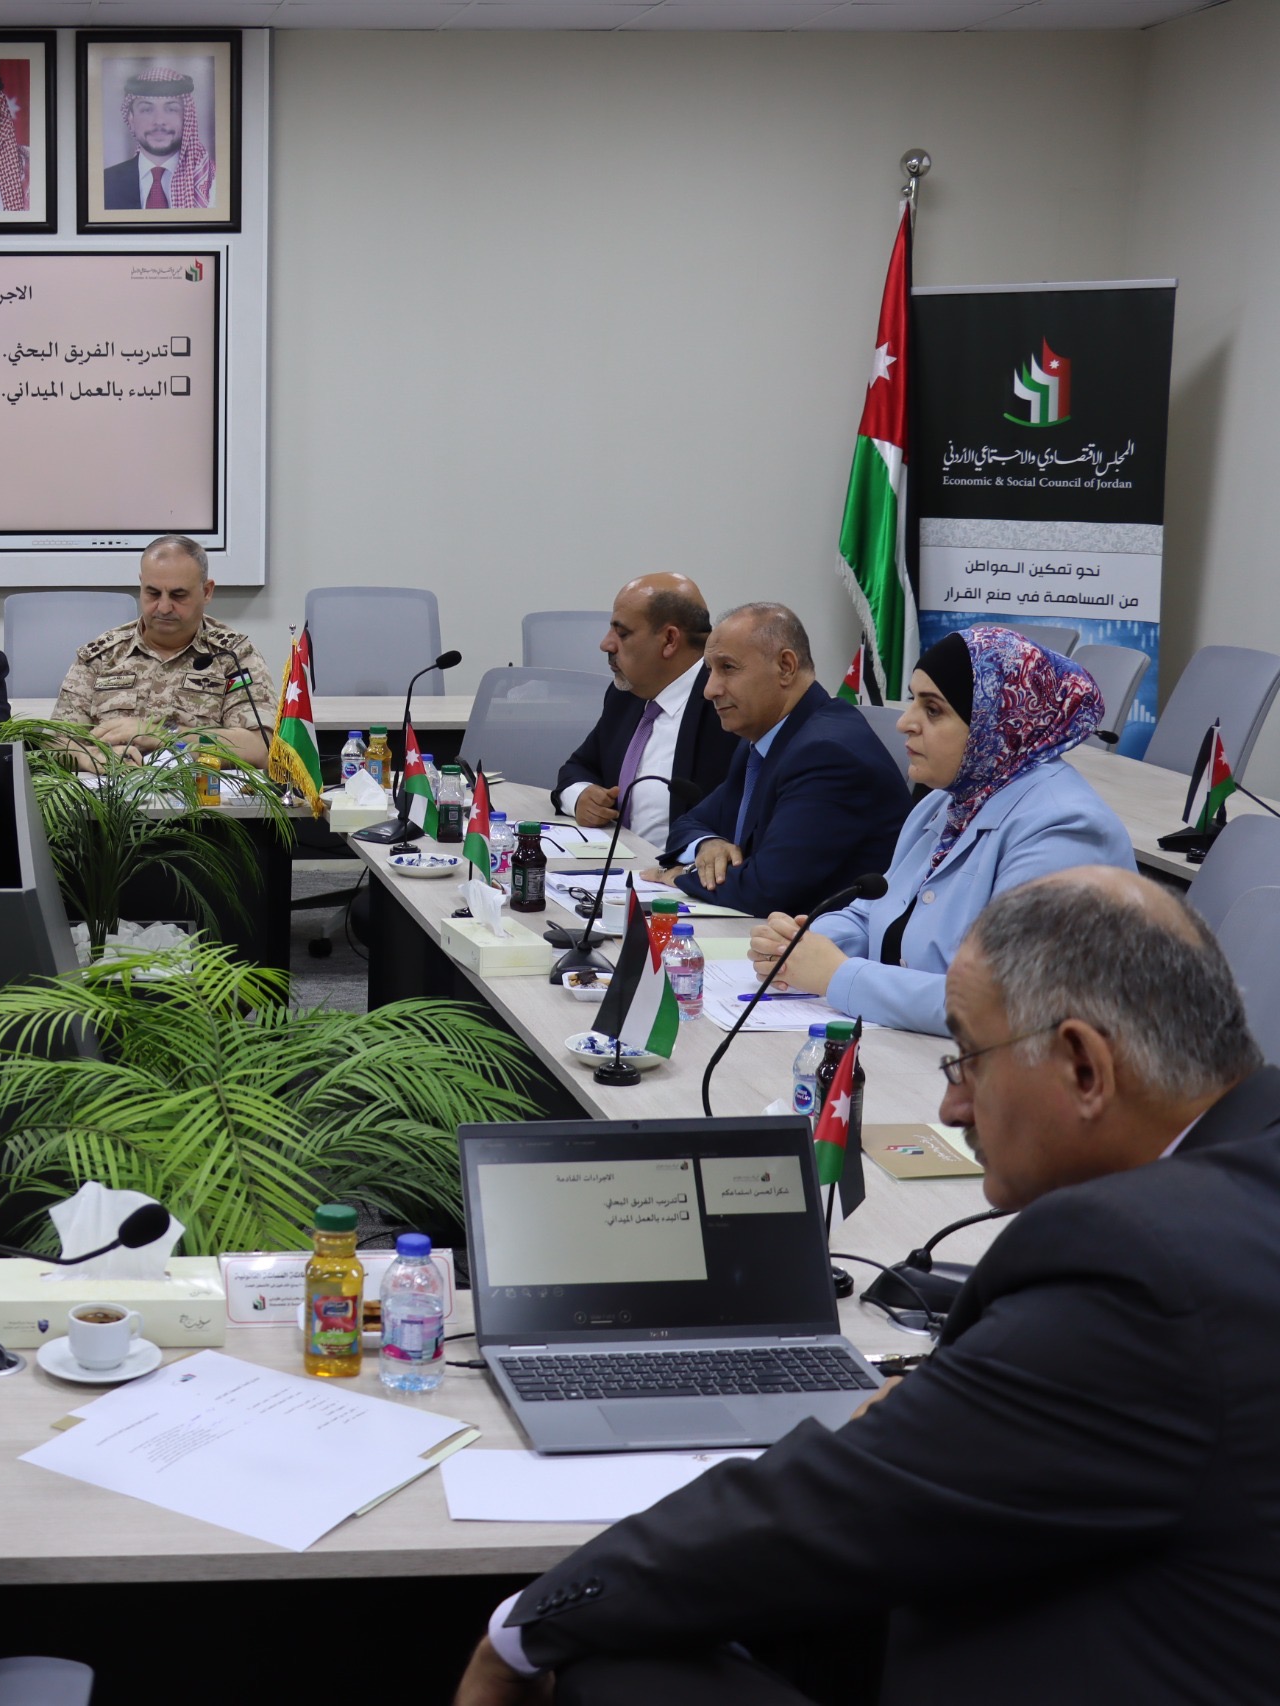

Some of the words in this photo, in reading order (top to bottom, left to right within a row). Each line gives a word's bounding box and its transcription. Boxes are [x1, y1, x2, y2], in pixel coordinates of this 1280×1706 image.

[64, 340, 115, 366] الفريق
[120, 344, 169, 366] تدريب
[69, 379, 124, 402] بالعمل
[128, 380, 168, 401] البدء
[1095, 439, 1135, 477] المجلس
[942, 475, 992, 486] Economic
[995, 476, 1005, 486] &
[1006, 476, 1036, 487] Social
[1038, 477, 1081, 488] Council
[1083, 477, 1096, 488] of
[1095, 478, 1132, 491] Jordan
[1028, 563, 1072, 578] تمكين
[1075, 564, 1100, 580] نحو
[985, 588, 1012, 604] صنع
[1017, 590, 1040, 605] في
[1043, 591, 1114, 606] المساهمة
[1118, 594, 1139, 610] من
